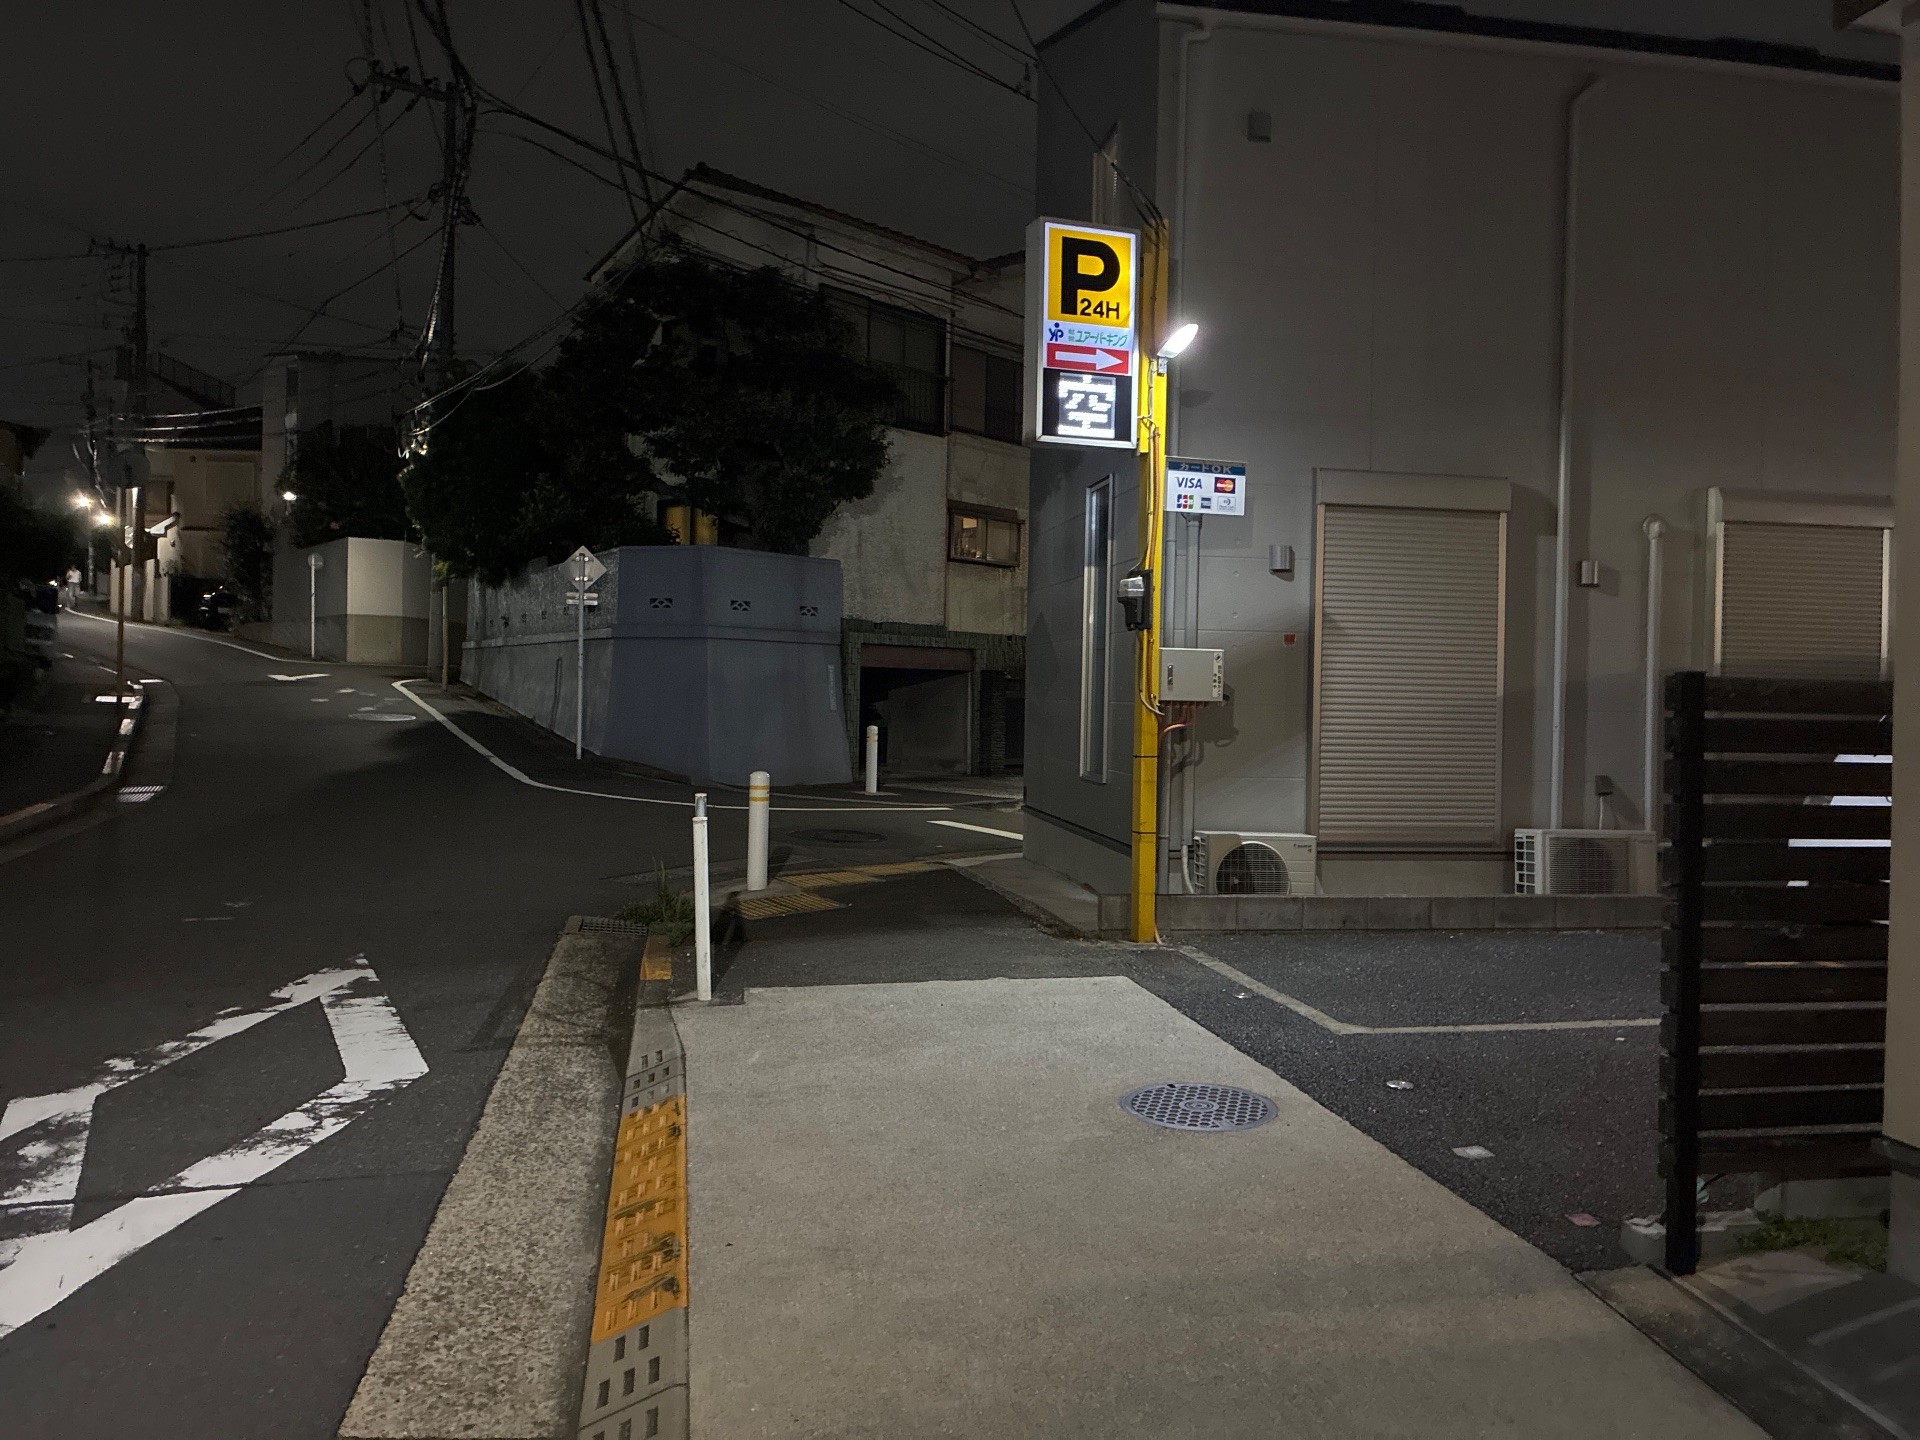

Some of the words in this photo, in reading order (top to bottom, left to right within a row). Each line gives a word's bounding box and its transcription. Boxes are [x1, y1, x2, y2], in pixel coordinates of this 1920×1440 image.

[1061, 236, 1120, 315] P
[1080, 298, 1119, 319] 24H
[1058, 374, 1115, 438] 空
[1175, 477, 1202, 489] VISA
